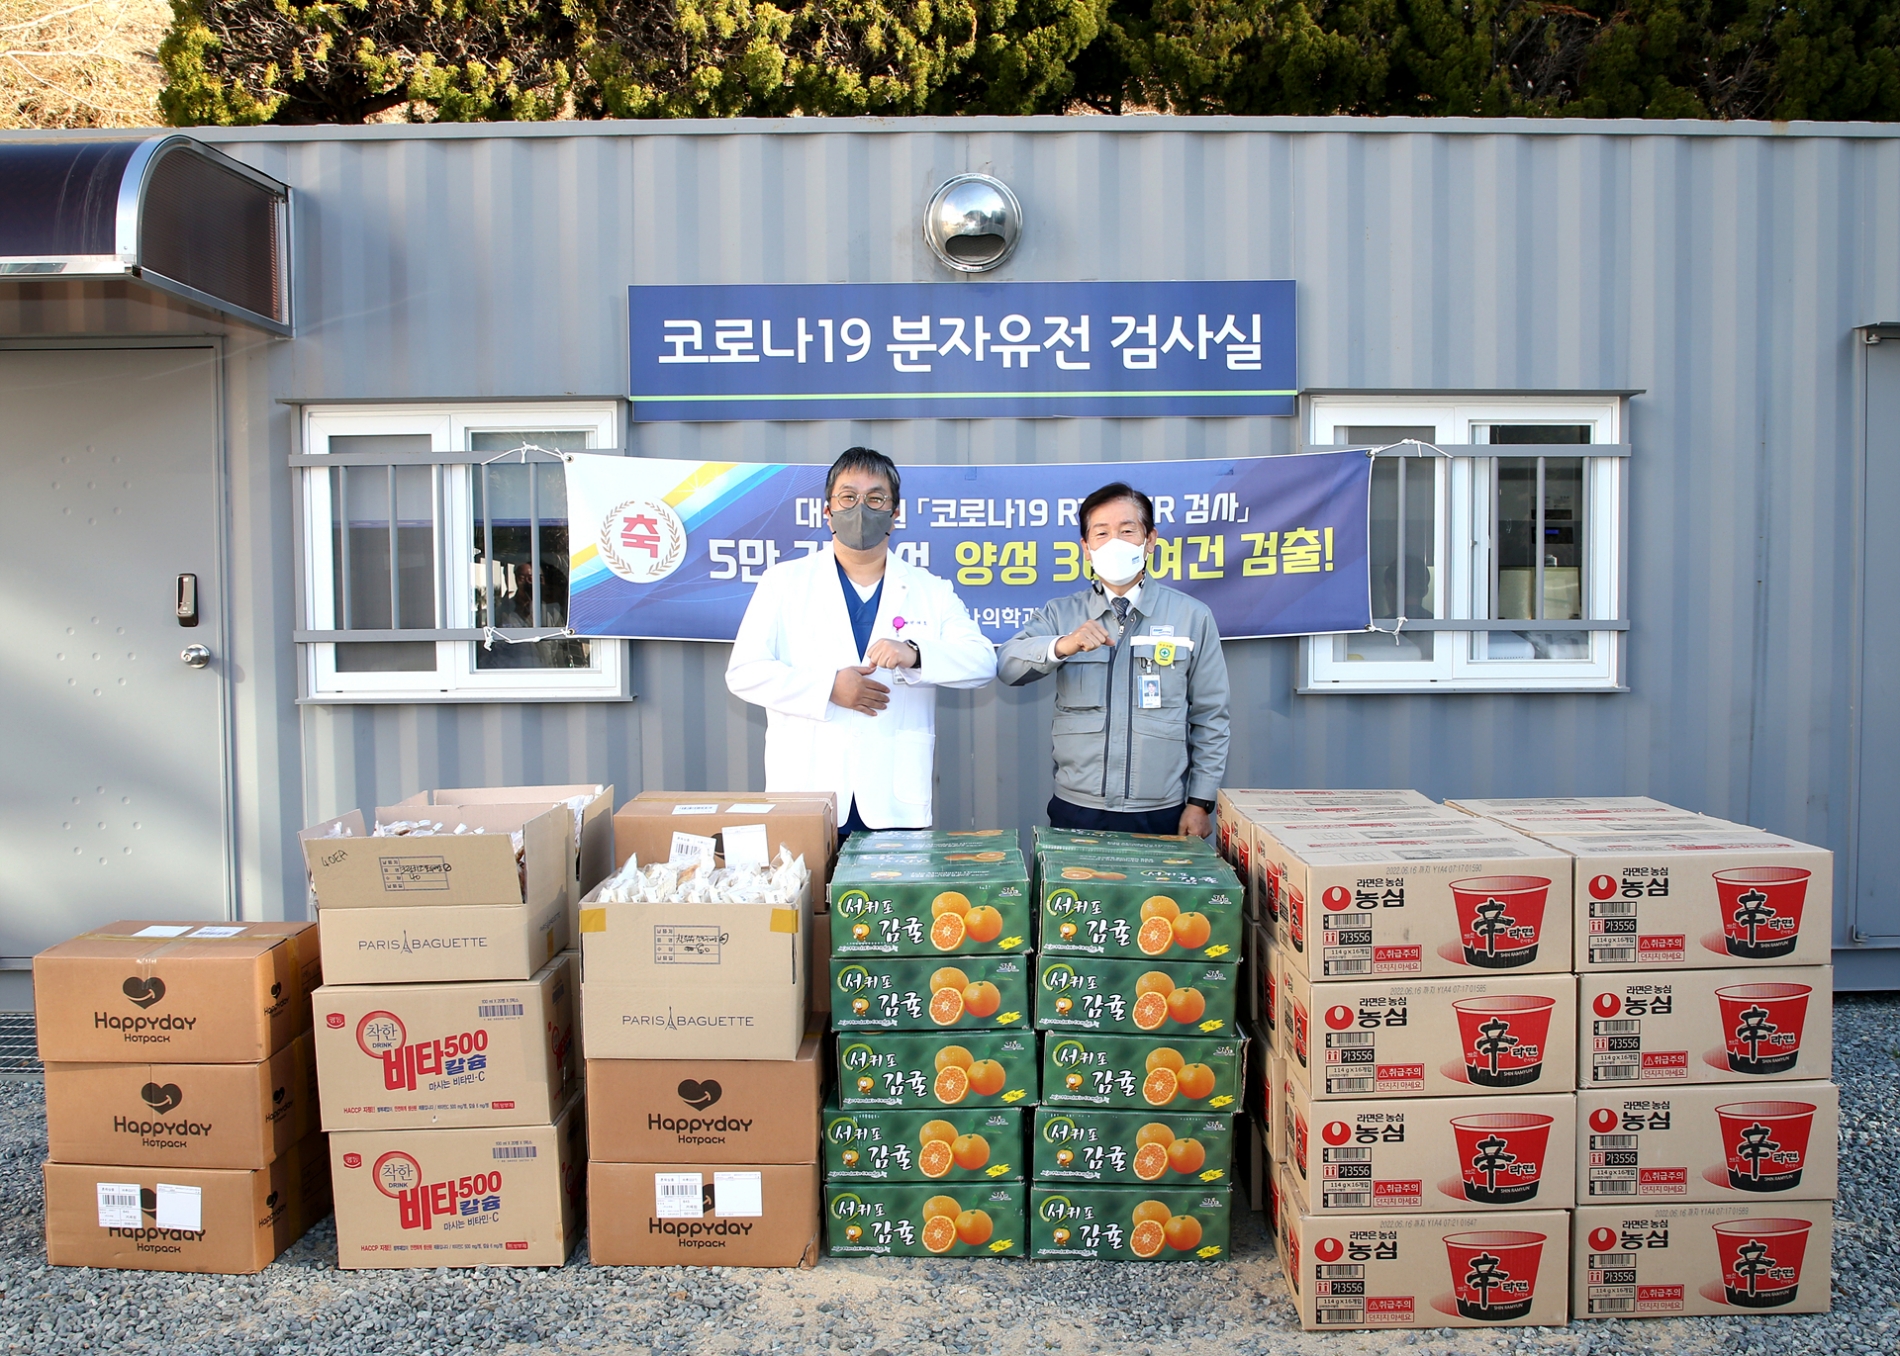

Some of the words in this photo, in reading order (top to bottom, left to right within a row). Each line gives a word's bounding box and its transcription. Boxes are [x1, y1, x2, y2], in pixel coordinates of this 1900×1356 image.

[658, 317, 871, 363] 코로나19
[886, 314, 1091, 372] 분자유전
[1110, 313, 1262, 371] 검사실
[620, 514, 660, 558] 축
[955, 541, 1038, 586] 양성
[1240, 527, 1334, 577] 검출!
[1623, 866, 1649, 877] 라면은
[1651, 867, 1668, 877] 농심
[1357, 878, 1383, 888] 라면은
[1386, 878, 1404, 887] 농심
[1620, 877, 1669, 899] 농심
[846, 898, 894, 915] 서귀포
[1054, 896, 1103, 916] 서귀포
[1355, 888, 1404, 910] 농심
[1605, 920, 1635, 932] 가3556
[1734, 889, 1776, 948] 辛
[1769, 916, 1794, 930] 라면
[879, 917, 924, 944] 감귤
[1086, 917, 1132, 947] 감귤
[1473, 899, 1515, 957] 辛
[1509, 926, 1534, 939] 라면
[358, 940, 400, 950] PARIS
[411, 937, 488, 949] BAGUETTE
[1340, 932, 1370, 943] 가3556
[1651, 938, 1682, 949] 취급주의
[1387, 949, 1418, 959] 취급주의
[1661, 952, 1682, 960] 마세요
[1398, 963, 1418, 971] 마세요
[845, 973, 893, 990] 서귀포
[1050, 972, 1098, 991] 서귀포
[1626, 985, 1652, 995] 라면은
[1654, 985, 1672, 994] 농심
[878, 991, 923, 1019] 감귤
[1081, 992, 1127, 1021] 감귤
[1359, 997, 1386, 1007] 라면은
[1389, 997, 1407, 1007] 농심
[1624, 995, 1672, 1016] 농심
[94, 1012, 197, 1032] Happyday
[622, 1015, 665, 1026] PARIS
[677, 1016, 754, 1027] BAGUETTE
[1357, 1007, 1407, 1029] 농심
[366, 1023, 397, 1041] 착한
[1736, 1006, 1777, 1063] 辛
[1770, 1032, 1795, 1046] 라면
[1476, 1018, 1519, 1076] 辛
[1512, 1045, 1538, 1058] 라면
[1609, 1038, 1639, 1049] 가3556
[850, 1051, 897, 1069] 서귀포
[1061, 1048, 1108, 1067] 서귀포
[1342, 1050, 1373, 1062] 가3556
[1654, 1055, 1684, 1065] 취급주의
[445, 1054, 487, 1076] 칼슘
[1389, 1067, 1421, 1078] 취급주의
[1664, 1069, 1684, 1077] 마세요
[429, 1080, 450, 1091] 마시는
[883, 1070, 928, 1097] 감귤
[1091, 1068, 1137, 1097] 감귤
[1400, 1081, 1421, 1089] 마세요
[1623, 1100, 1650, 1110] 라면은
[1652, 1101, 1670, 1110] 농심
[114, 1116, 212, 1137] Happyday
[648, 1113, 752, 1134] Happyday
[1357, 1113, 1384, 1123] 라면은
[1386, 1113, 1404, 1123] 농심
[1621, 1110, 1670, 1132] 농심
[835, 1125, 882, 1142] 서귀포
[1051, 1124, 1099, 1143] 서귀포
[1355, 1123, 1405, 1145] 농심
[868, 1143, 913, 1171] 감귤
[1082, 1144, 1127, 1172] 감귤
[1606, 1153, 1636, 1165] 가3556
[1737, 1123, 1780, 1181] 辛
[1773, 1150, 1799, 1164] 라면
[382, 1163, 413, 1182] 착한
[1340, 1166, 1370, 1177] 가3556
[1473, 1135, 1516, 1193] 辛
[1509, 1162, 1535, 1176] 라면
[1652, 1171, 1684, 1182] 취급주의
[1386, 1183, 1418, 1194] 취급주의
[1663, 1185, 1684, 1193] 마세요
[459, 1195, 501, 1216] 칼슘
[838, 1200, 886, 1218] 서귀포
[1397, 1197, 1418, 1205] 마세요
[1047, 1203, 1095, 1221] 서귀포
[444, 1219, 465, 1231] 마시는
[649, 1217, 753, 1237] Happyday
[871, 1219, 916, 1246] 감귤
[1622, 1219, 1648, 1229] 라면은
[1650, 1219, 1668, 1229] 농심
[109, 1227, 206, 1242] Happyday
[1079, 1222, 1124, 1250] 감귤
[1350, 1230, 1377, 1240] 라면은
[1379, 1230, 1397, 1240] 농심
[1620, 1229, 1668, 1250] 농심
[1348, 1240, 1398, 1262] 농심
[1605, 1271, 1634, 1282] 가3556
[1734, 1240, 1776, 1297] 辛
[1769, 1267, 1795, 1280] 라면
[1333, 1282, 1363, 1294] 가3556
[1466, 1253, 1509, 1310] 辛
[1502, 1280, 1528, 1293] 라면
[1650, 1288, 1681, 1298] 취급주의
[1379, 1300, 1411, 1310] 취급주의
[1660, 1301, 1680, 1310] 마세요
[1390, 1313, 1411, 1321] 마세요
